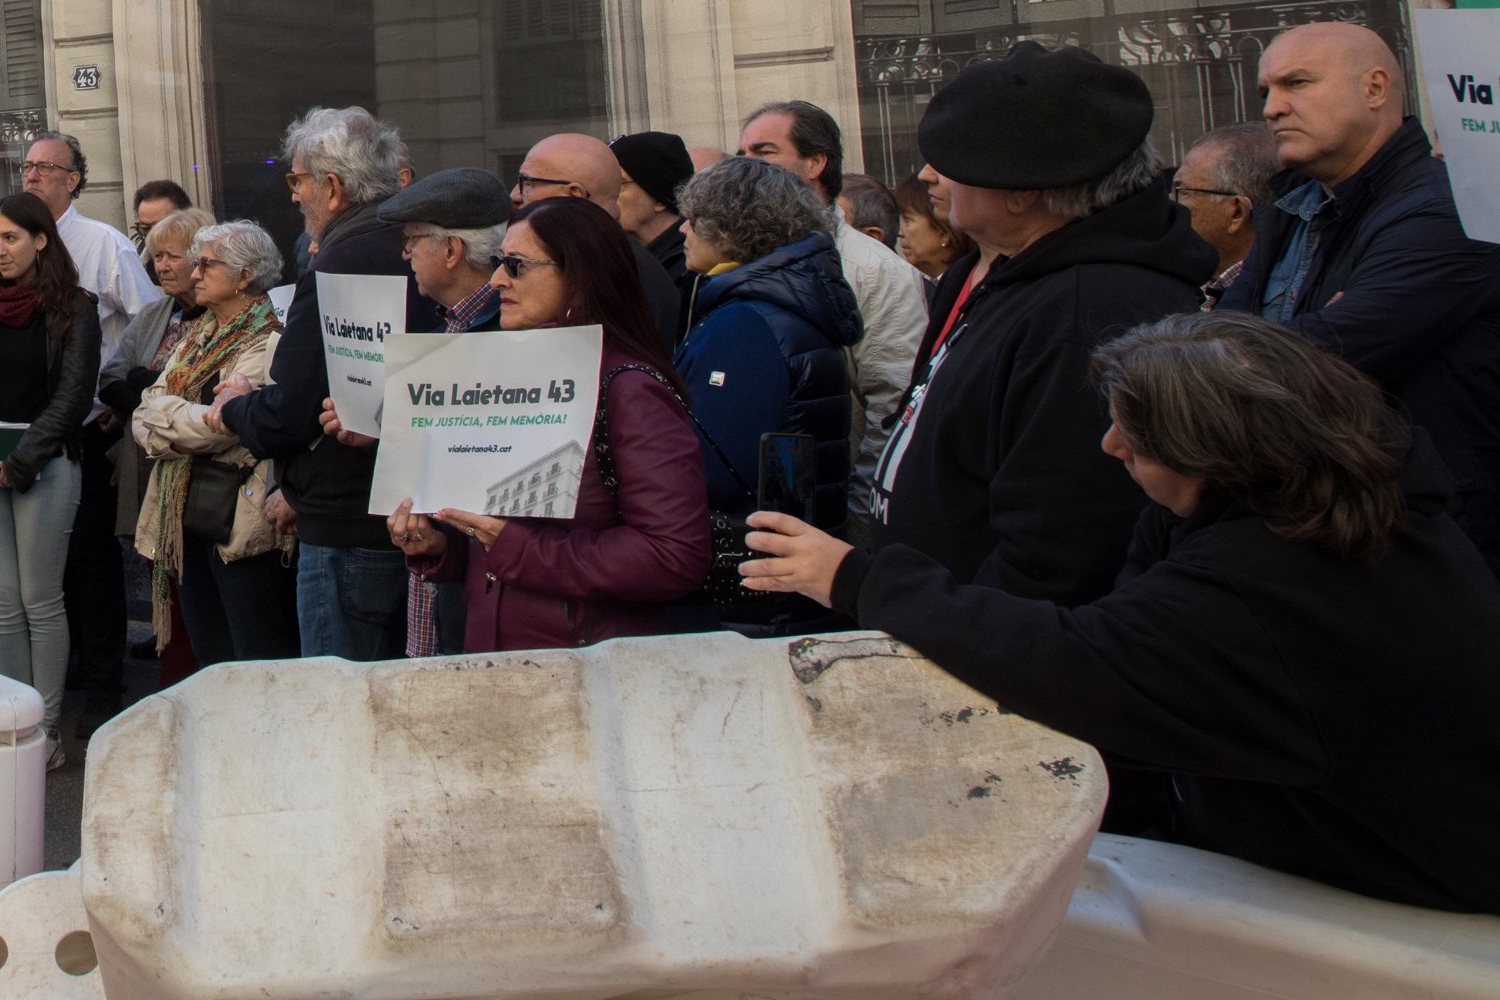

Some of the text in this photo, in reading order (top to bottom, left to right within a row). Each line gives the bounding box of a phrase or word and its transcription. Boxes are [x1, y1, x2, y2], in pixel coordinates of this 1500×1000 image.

[77, 68, 97, 87] 43
[1446, 74, 1493, 105] Via
[1461, 118, 1486, 133] FEM
[324, 315, 335, 336] Via
[335, 317, 374, 342] Laietana
[407, 379, 575, 406] Via Laietana 43
[412, 412, 568, 428] FEM JUSTÍCIA, FEM MEMÒRIA!
[448, 444, 512, 453] vialaietana43.cat
